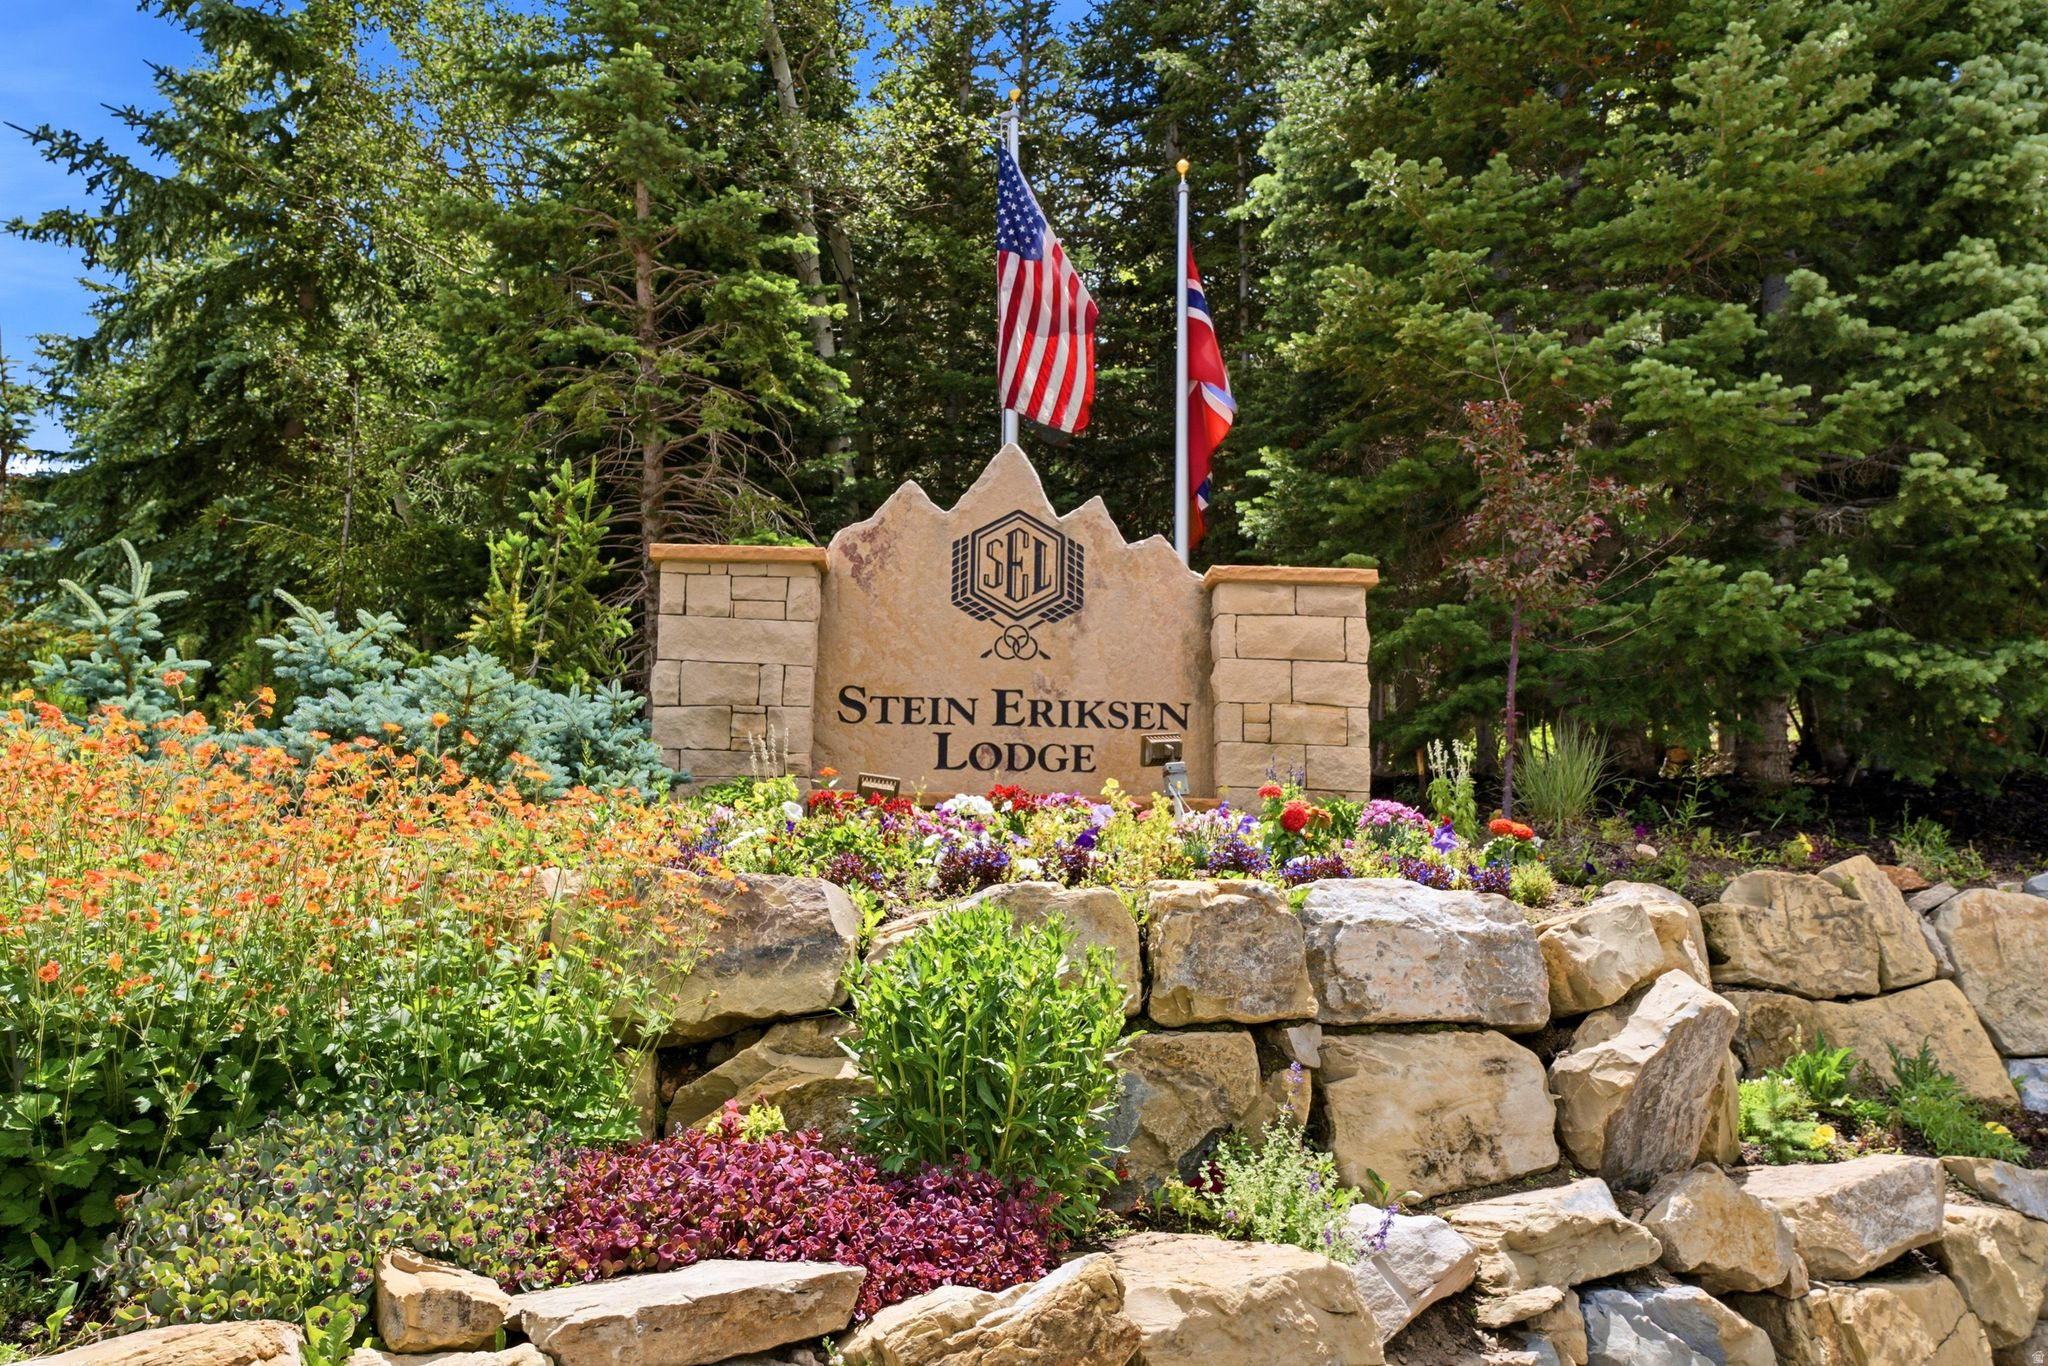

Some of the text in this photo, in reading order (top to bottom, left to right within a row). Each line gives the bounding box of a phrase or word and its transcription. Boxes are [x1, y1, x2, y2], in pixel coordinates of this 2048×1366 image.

[984, 528, 1052, 602] SEL
[837, 686, 1191, 730] STEIN ERIKSEN
[934, 732, 1096, 772] LODGE
